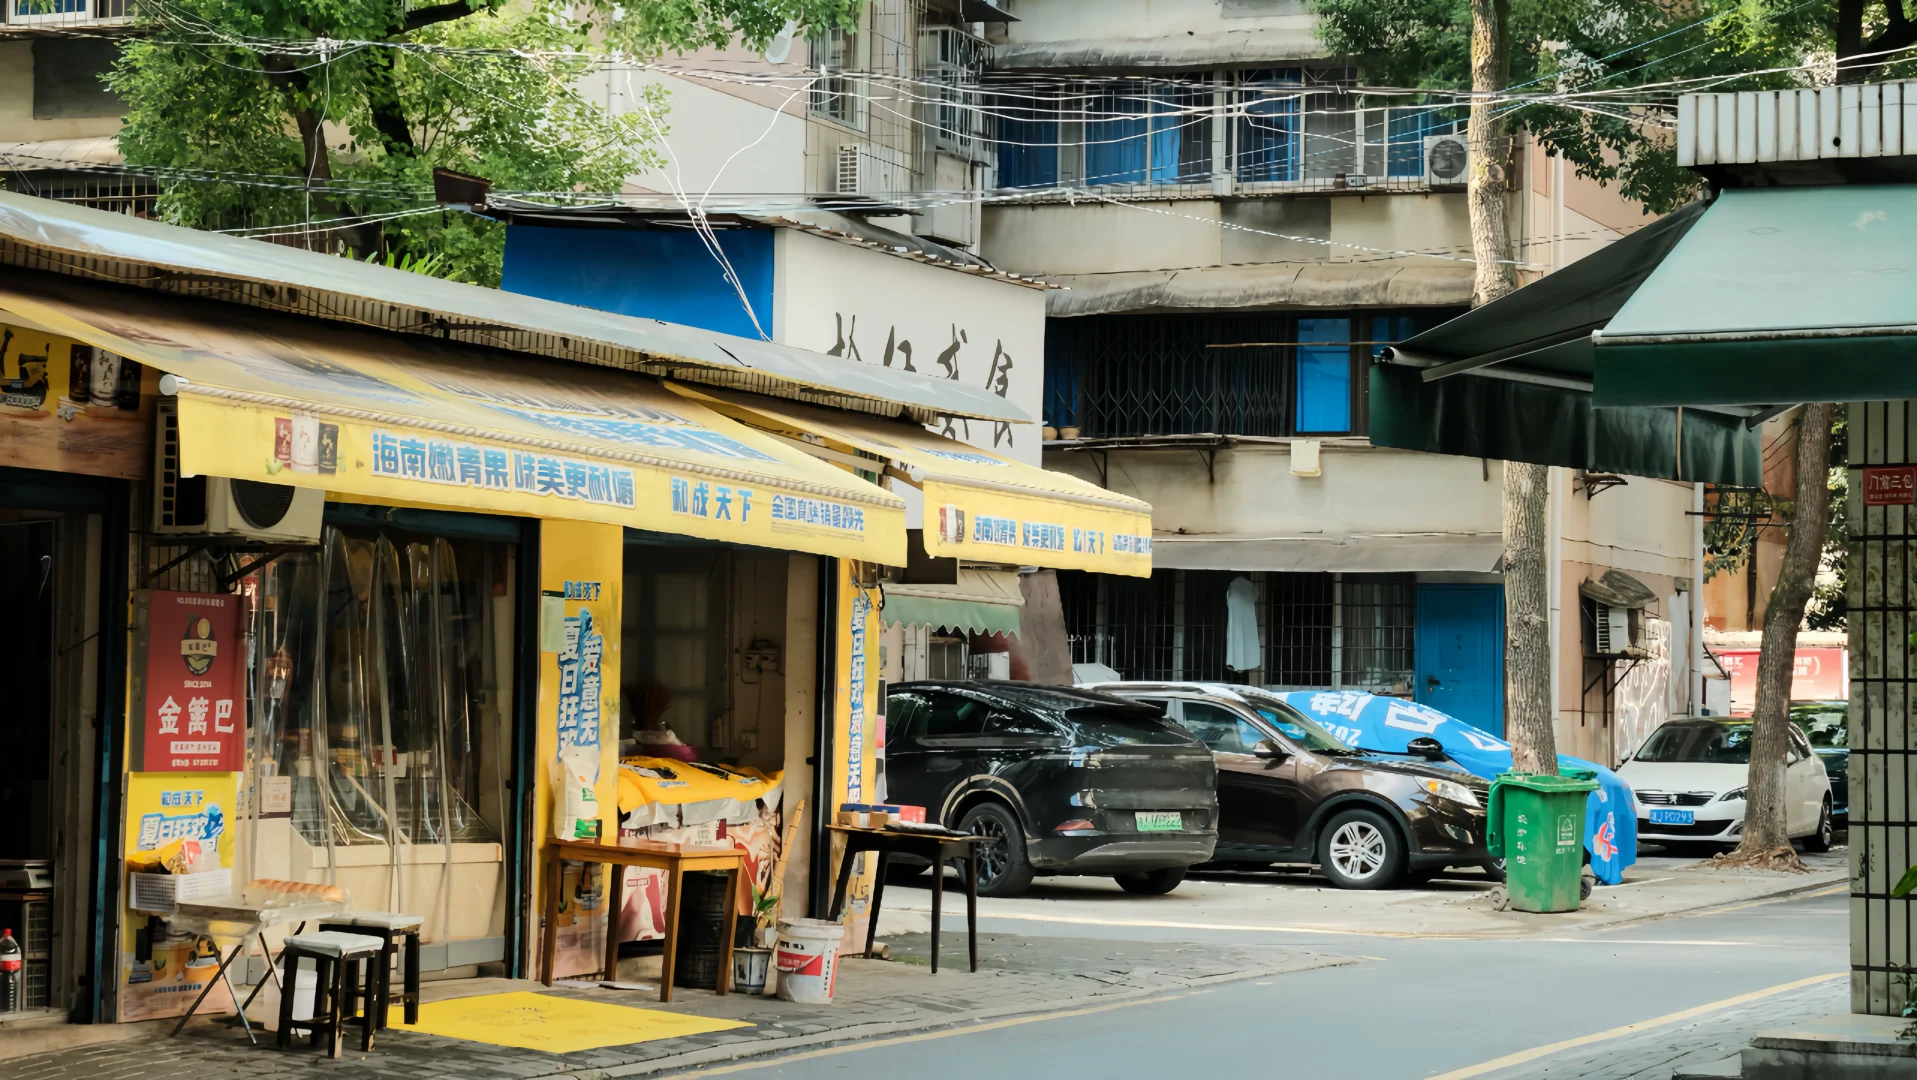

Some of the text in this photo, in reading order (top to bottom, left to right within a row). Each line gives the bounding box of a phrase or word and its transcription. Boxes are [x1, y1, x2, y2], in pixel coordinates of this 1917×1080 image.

[372, 432, 509, 486] 海南嫩青果
[671, 477, 753, 522] 和成天下
[579, 639, 602, 752] 爱意无
